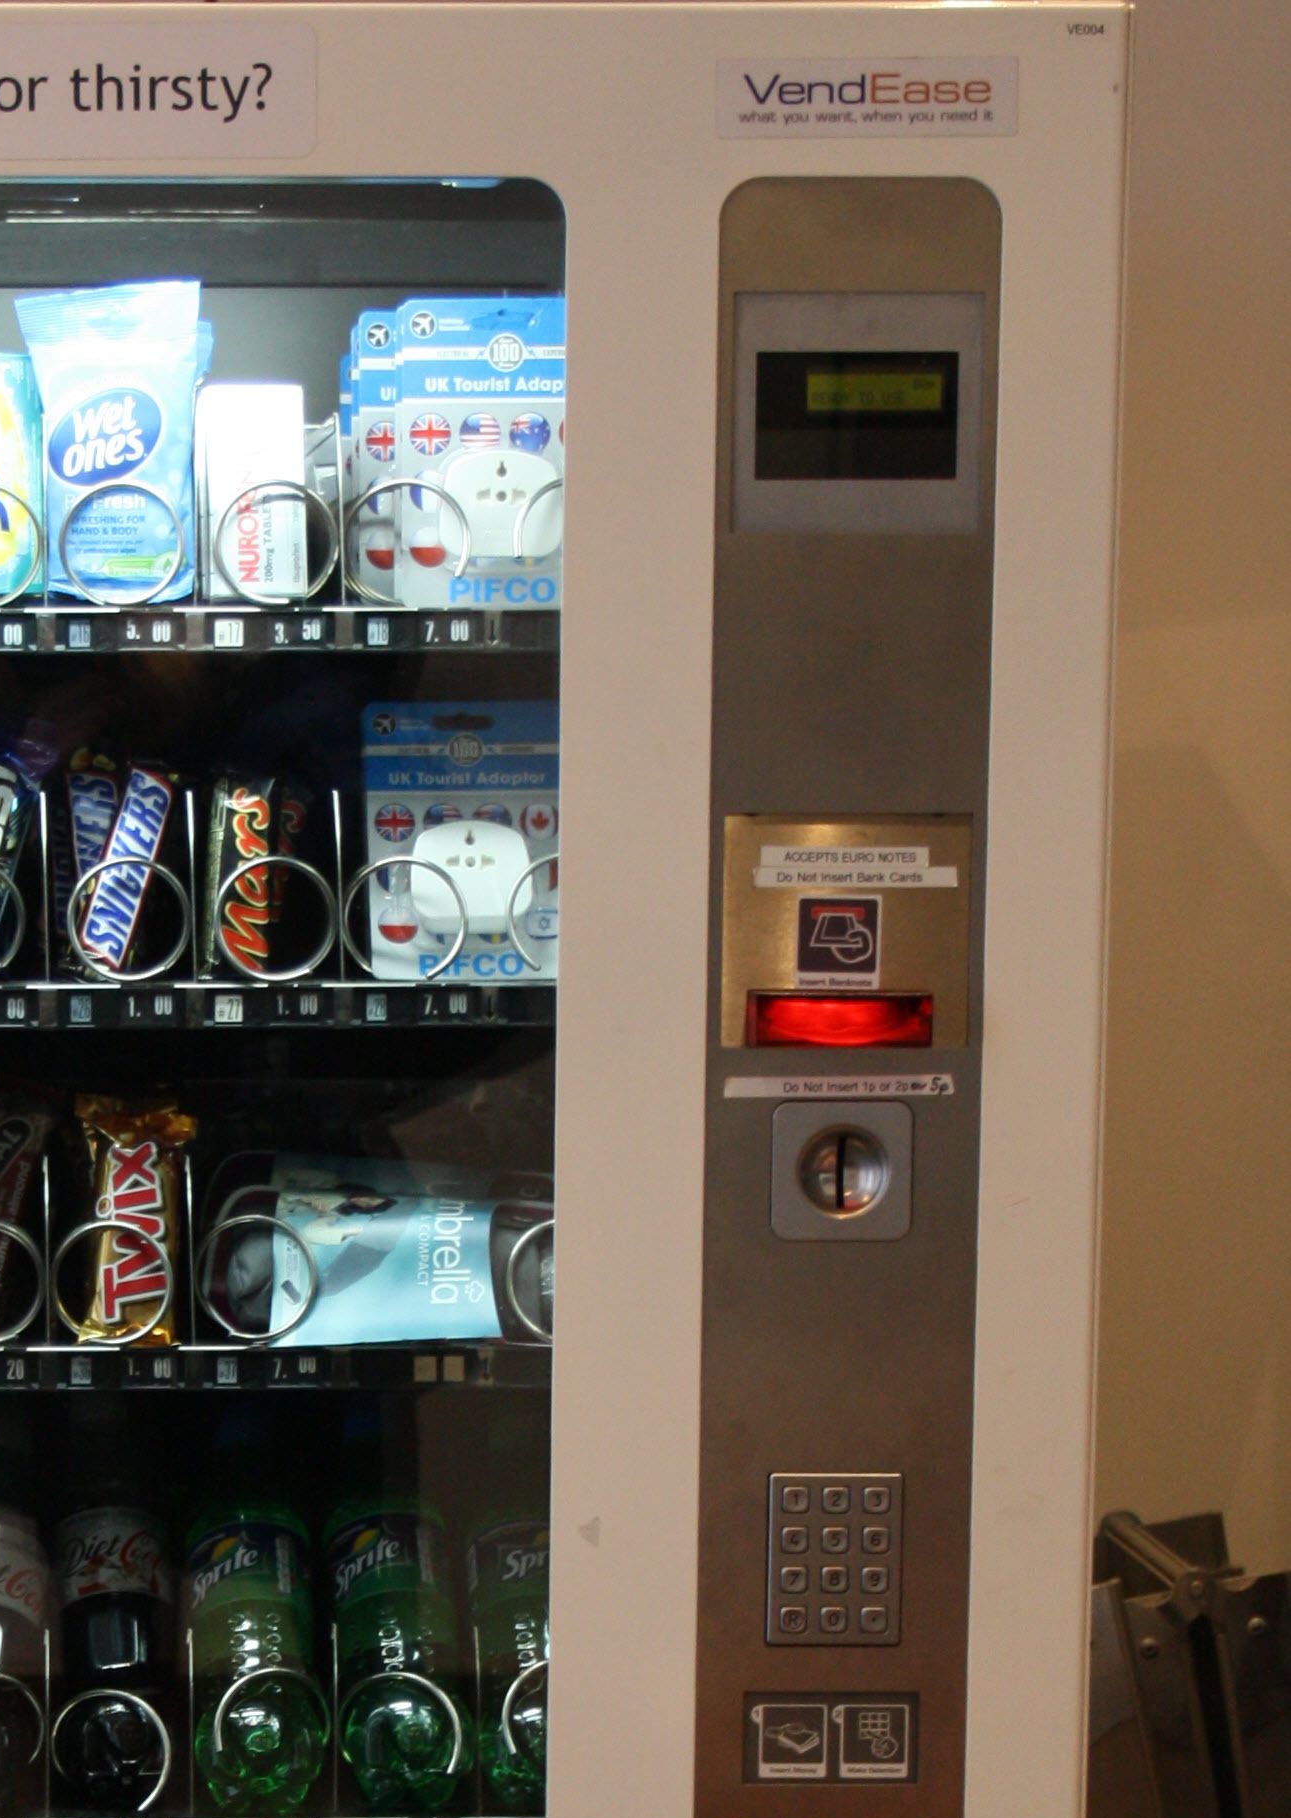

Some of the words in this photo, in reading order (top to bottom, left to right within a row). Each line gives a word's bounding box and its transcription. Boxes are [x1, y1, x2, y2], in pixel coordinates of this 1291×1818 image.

[1066, 24, 1105, 36] VE004
[70, 62, 274, 125] thirsty?
[744, 73, 992, 105] VendEase
[739, 109, 777, 123] what
[783, 111, 808, 126] you
[862, 108, 903, 123] when
[908, 110, 935, 126] you
[940, 108, 977, 123] need
[983, 109, 993, 122] it
[424, 377, 449, 393] UK
[453, 376, 510, 393] Tourist
[515, 376, 564, 397] Adap
[449, 577, 556, 604] PIFCO
[388, 771, 411, 785] UK
[417, 771, 471, 785] Tourist
[84, 768, 170, 956] SNICKERS
[784, 851, 839, 863] ACCEPTS
[842, 851, 874, 863] EURO
[878, 851, 917, 863] NOTES
[221, 787, 270, 971] Mars
[777, 871, 792, 883] Do
[797, 871, 818, 883] Not
[821, 871, 853, 883] Insert
[857, 871, 885, 883] Bank
[889, 871, 923, 883] Cards
[783, 1081, 799, 1093] Do
[803, 1081, 823, 1093] Not
[827, 1081, 859, 1092] Insert
[863, 1080, 876, 1094] 1p
[879, 1082, 891, 1092] or
[895, 1080, 910, 1094] 2p
[66, 1534, 119, 1576] Diet
[334, 1537, 400, 1598] Sprite
[502, 1546, 548, 1582] Spr
[192, 1548, 259, 1602] Sprite
